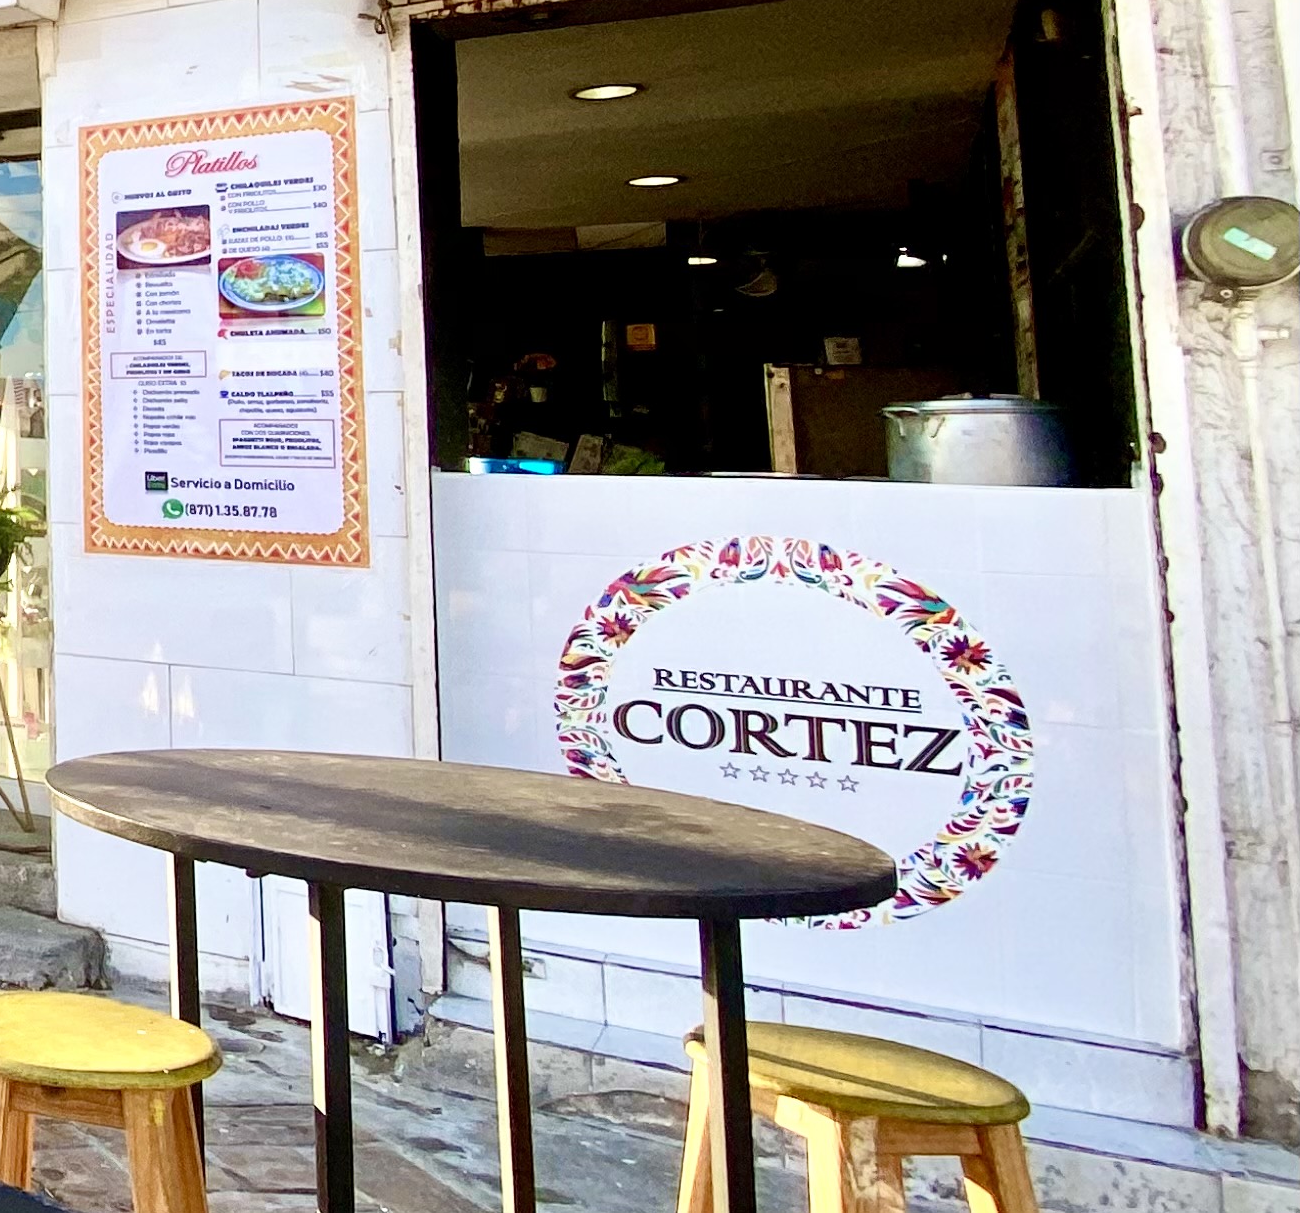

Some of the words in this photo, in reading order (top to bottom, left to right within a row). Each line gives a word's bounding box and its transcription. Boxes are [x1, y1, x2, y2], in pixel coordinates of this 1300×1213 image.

[165, 149, 258, 177] Platillos
[170, 477, 222, 489] Servicio
[224, 480, 231, 489] a
[234, 478, 295, 491] Domicilio
[185, 503, 213, 517] (871)
[653, 668, 921, 710] RESTAURANTE
[612, 700, 964, 776] CORTEZ
